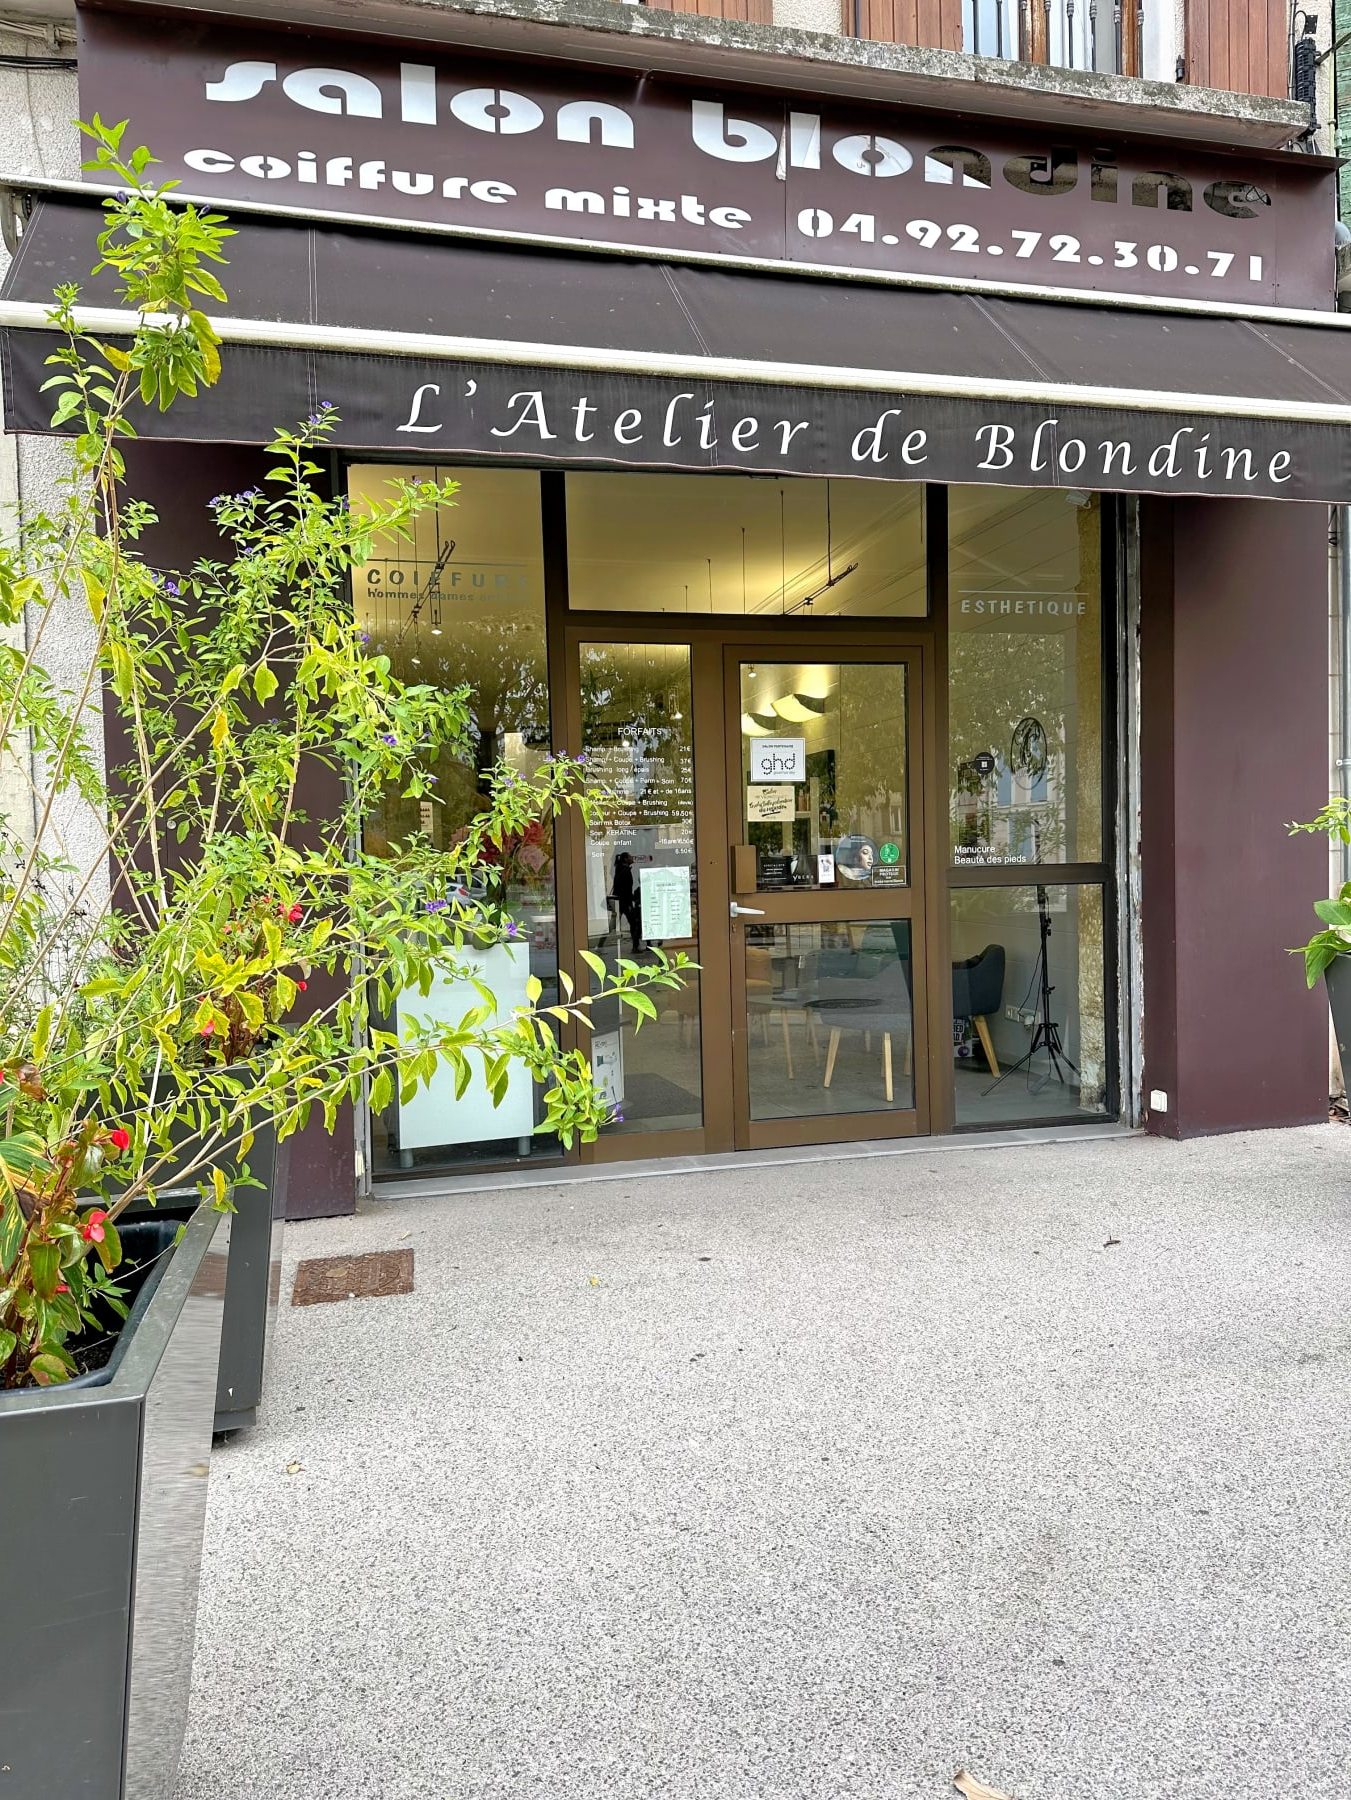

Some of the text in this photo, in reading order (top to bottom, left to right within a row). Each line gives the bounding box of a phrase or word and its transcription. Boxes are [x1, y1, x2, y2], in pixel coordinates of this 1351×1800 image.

[205, 60, 1272, 218] salon blondine
[184, 149, 1262, 281] coiffure mixte 04.92.72.30.71
[396, 379, 1292, 483] L'Atelier de Blondine
[961, 599, 1086, 616] ESTHETIQUE
[617, 727, 662, 736] FORFAITS
[639, 756, 665, 764] Brushing
[760, 753, 796, 776] ghd
[585, 766, 613, 774] Brushing
[616, 766, 629, 774] long
[642, 799, 668, 807] Brushing
[954, 845, 996, 854] Manucure
[954, 854, 1027, 865] Beauté des pieds
